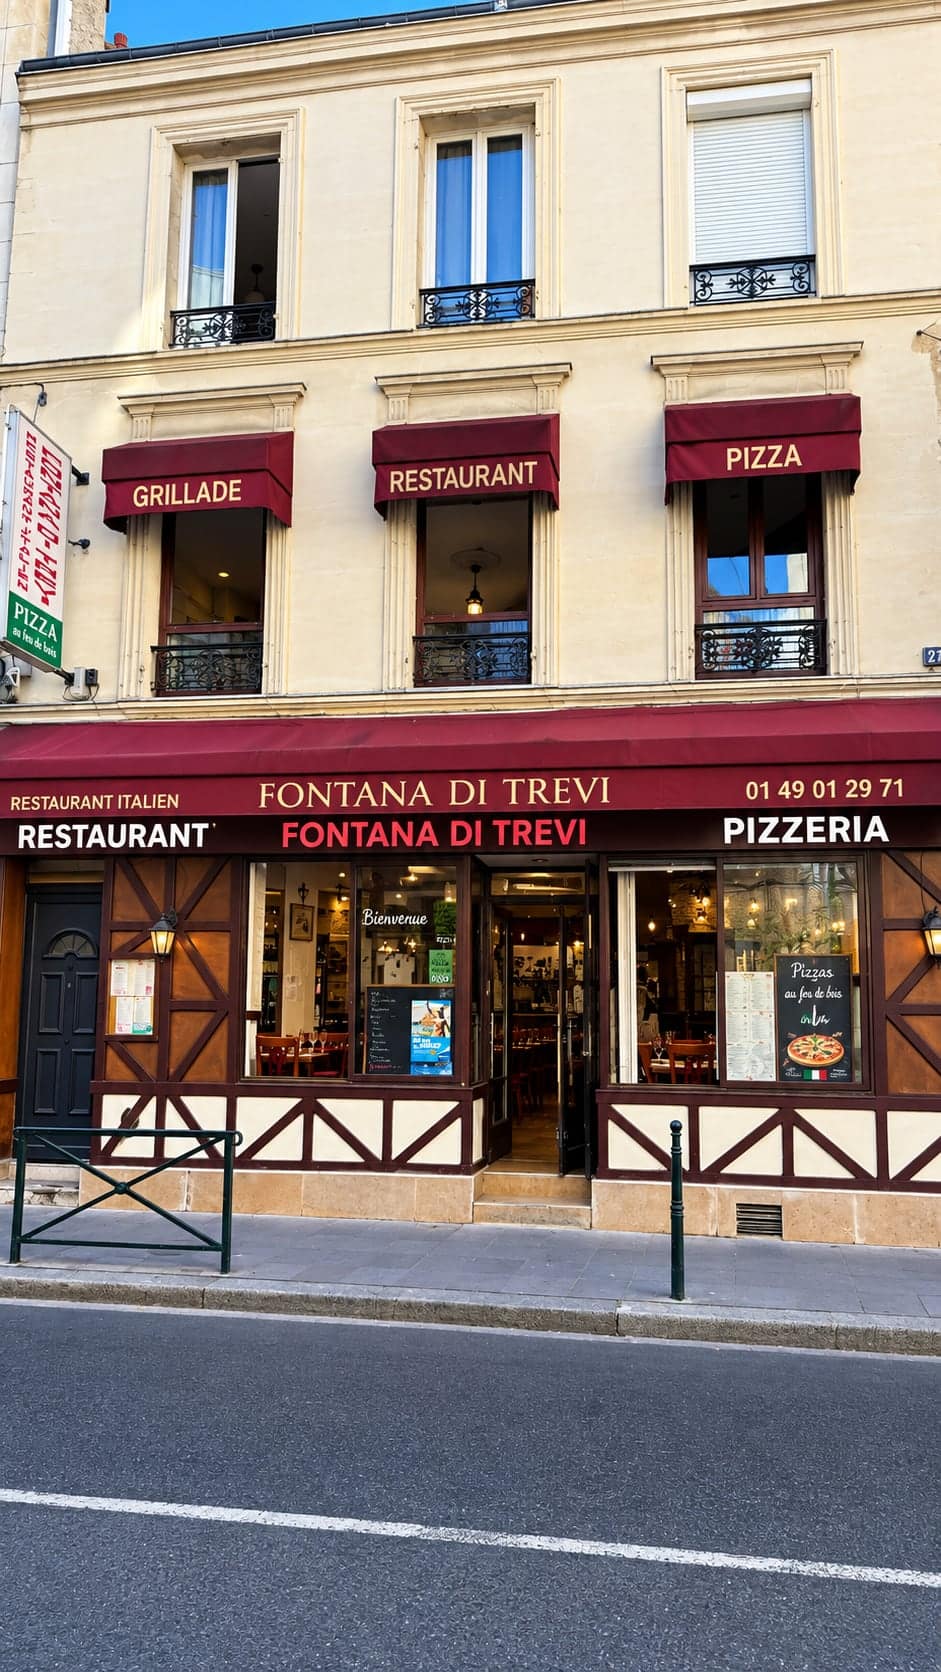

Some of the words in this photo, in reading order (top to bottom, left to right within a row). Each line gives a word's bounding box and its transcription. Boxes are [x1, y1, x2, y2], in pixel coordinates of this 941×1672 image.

[726, 443, 803, 471] PIZZA
[390, 460, 538, 493] RESTAURANT
[133, 479, 242, 508] GRILLADE
[14, 602, 58, 642] PIZZA
[10, 794, 114, 811] RESTAURANT
[117, 793, 180, 809] ITALIEN
[258, 779, 434, 809] FONTANA
[449, 778, 487, 807] DI
[502, 777, 610, 805] TREVI
[745, 782, 769, 801] 01
[777, 781, 805, 800] 49
[812, 781, 836, 799] 01
[845, 780, 872, 799] 29
[879, 778, 903, 798] 71
[18, 822, 209, 850] RESTAURANT
[282, 820, 440, 849] FONTANA
[450, 819, 482, 848] DI
[492, 818, 587, 847] TREVI
[723, 815, 890, 845] PIZZERIA
[362, 908, 429, 926] Bienvenue
[791, 961, 835, 982] Pizzas
